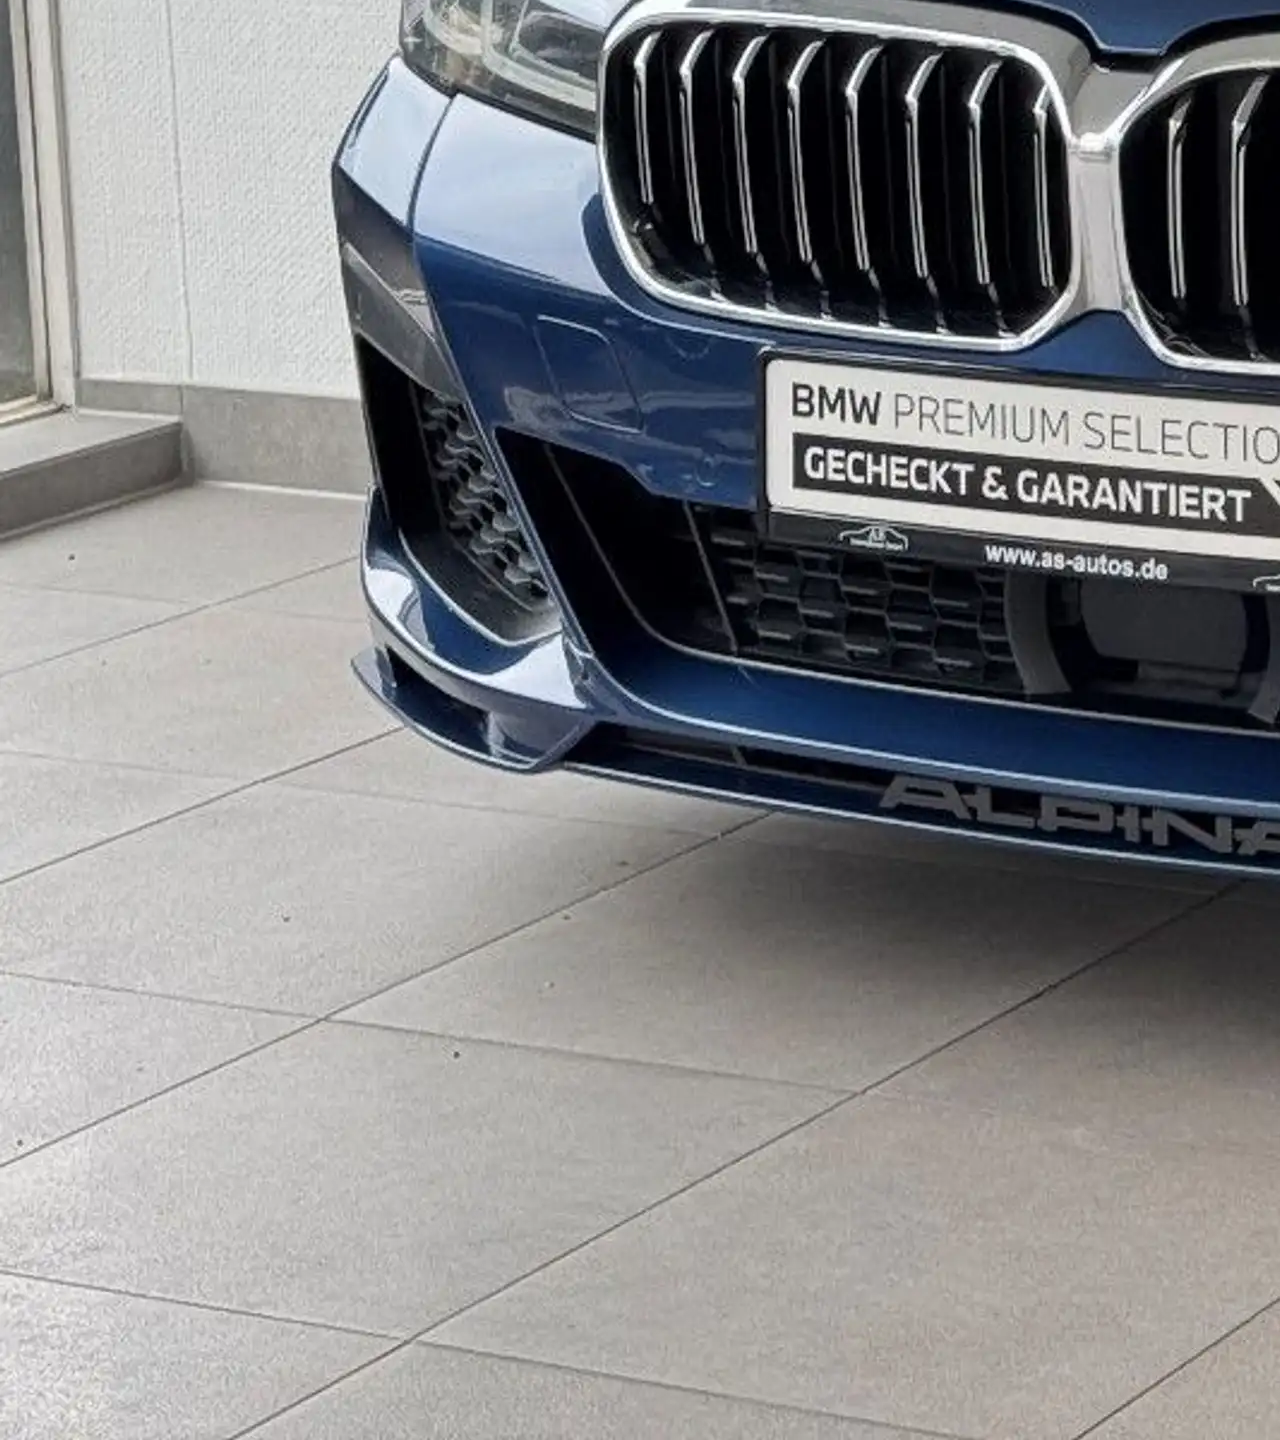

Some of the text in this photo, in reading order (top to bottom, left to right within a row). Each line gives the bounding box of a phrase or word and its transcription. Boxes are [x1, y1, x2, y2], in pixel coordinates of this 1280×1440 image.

[791, 383, 882, 427] BMW
[894, 393, 1070, 446] PREMIUM
[804, 445, 1253, 524] GECHECKT & GARANTIERT
[984, 544, 1168, 580] www.as-autos.de
